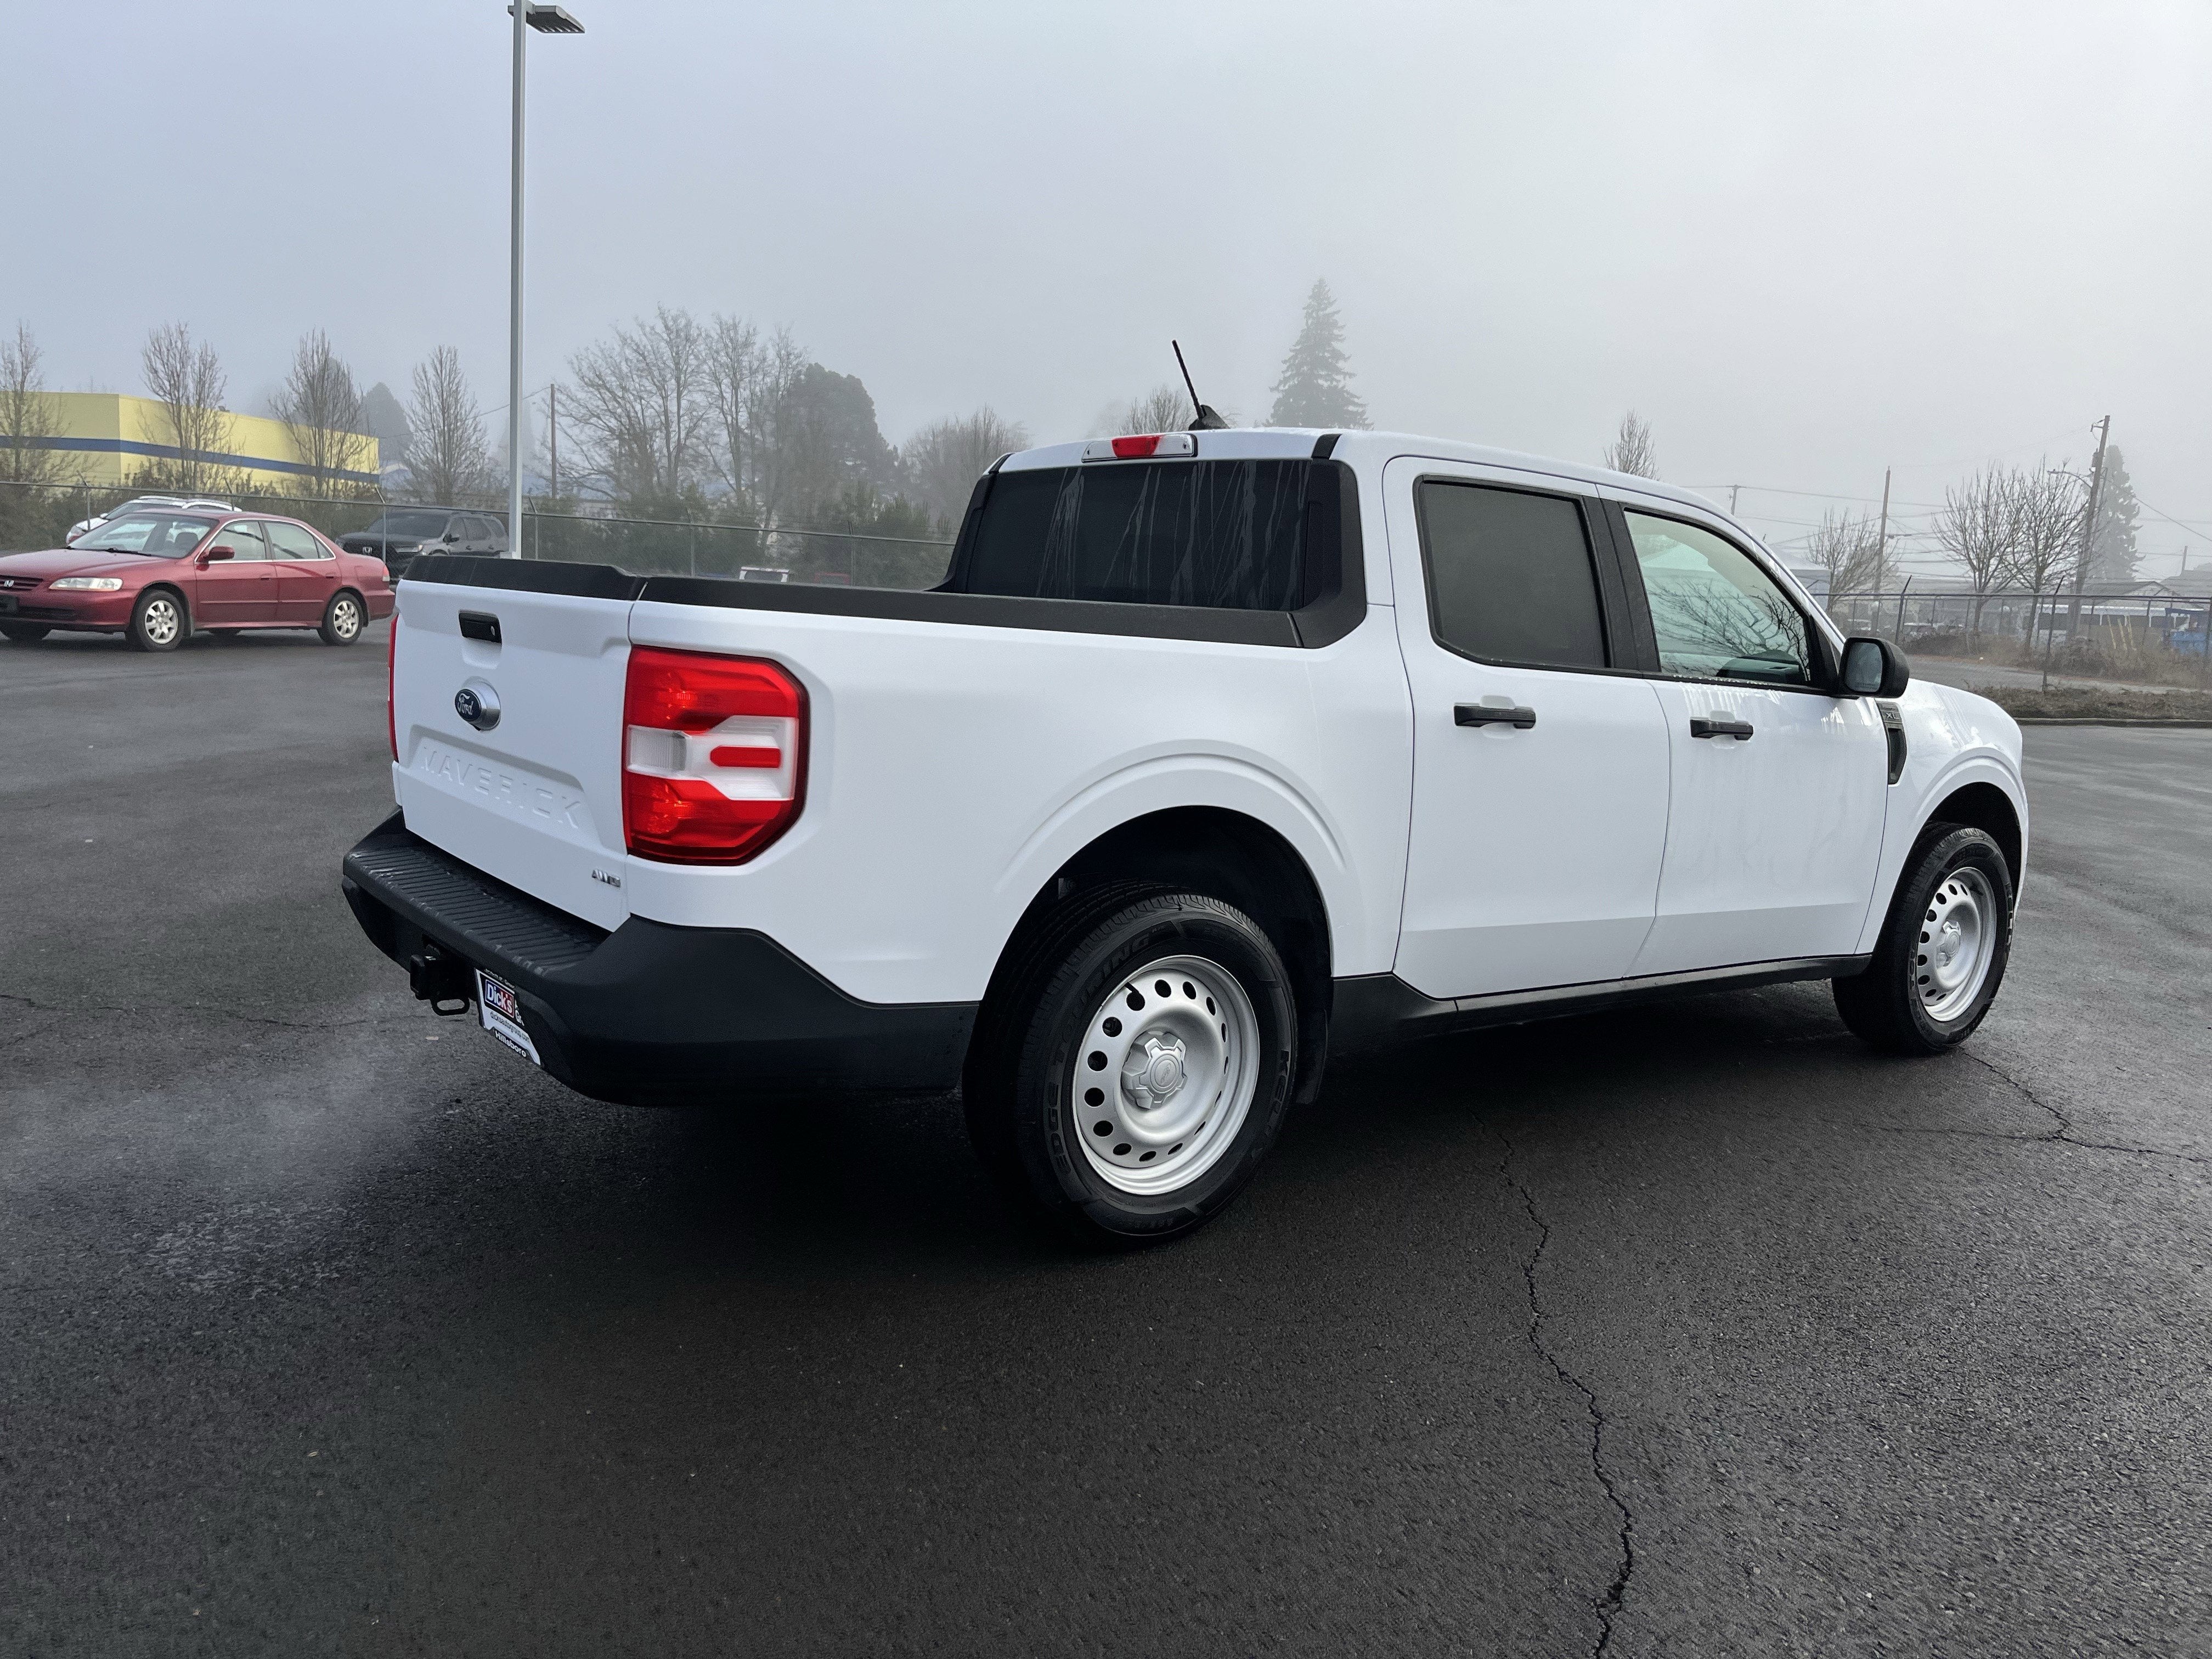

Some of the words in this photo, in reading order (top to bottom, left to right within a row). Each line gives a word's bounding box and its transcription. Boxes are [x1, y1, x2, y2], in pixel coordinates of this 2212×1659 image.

[458, 693, 474, 715] Ford
[421, 747, 580, 829] MAVERICK
[487, 983, 513, 1014] Dick's
[495, 1030, 527, 1058] Hillsboro
